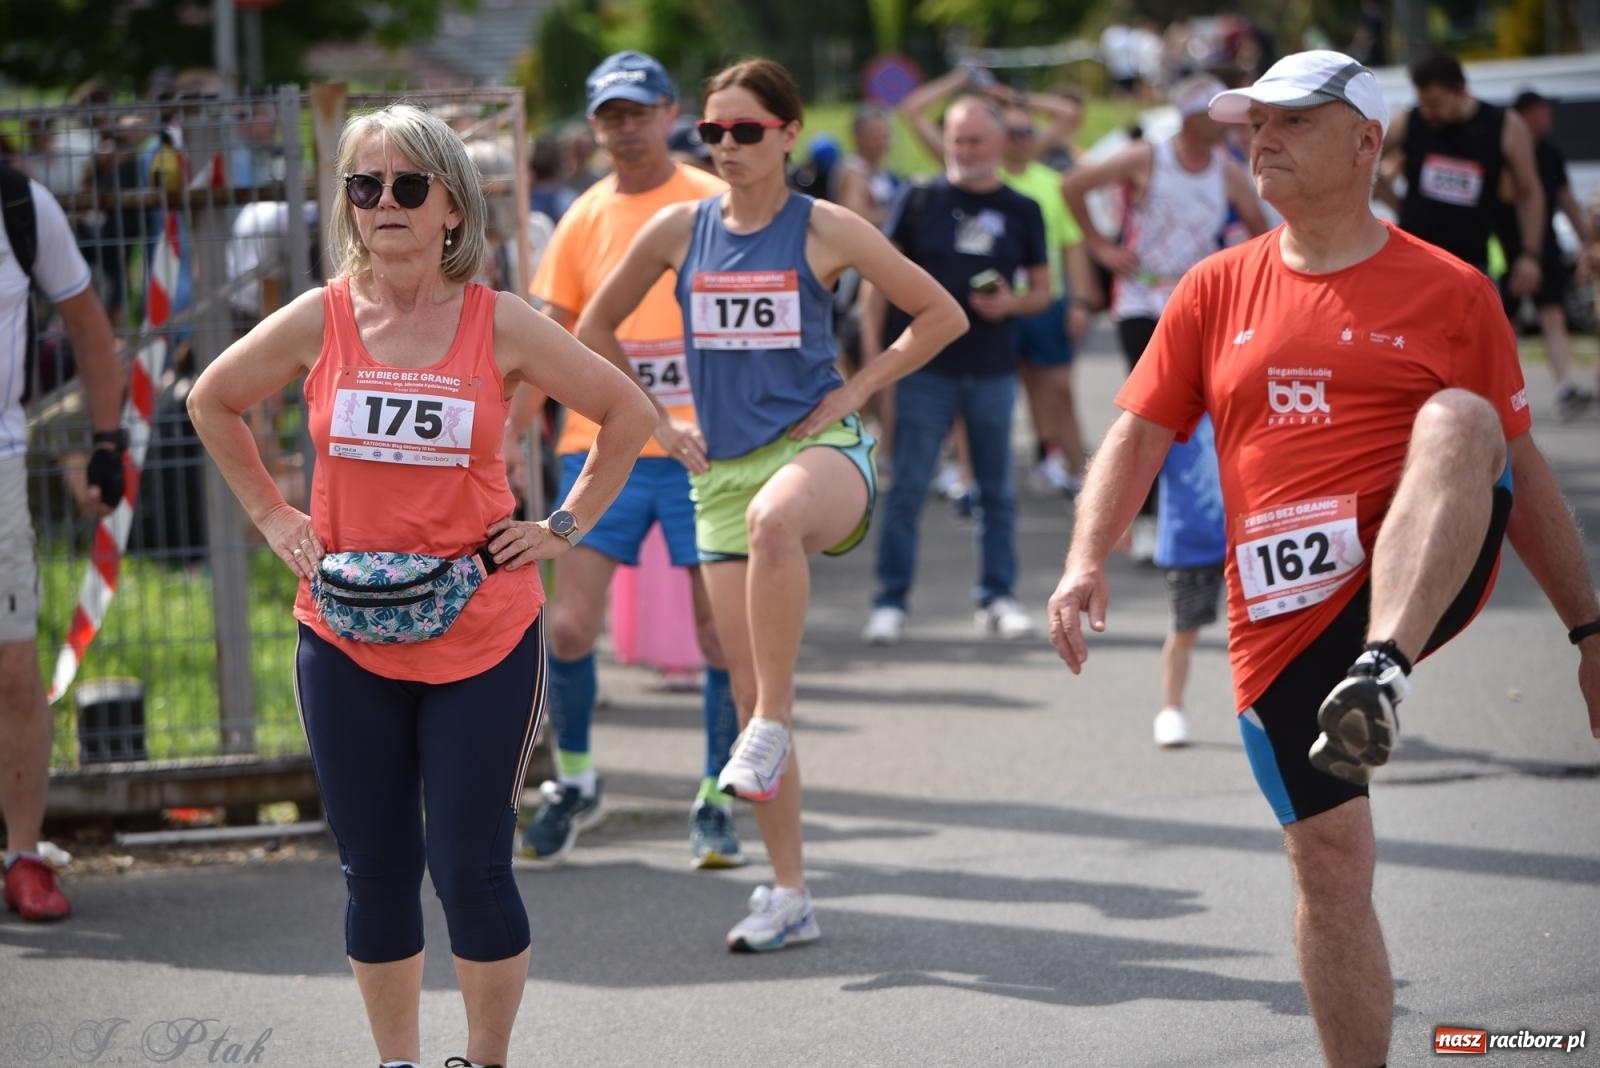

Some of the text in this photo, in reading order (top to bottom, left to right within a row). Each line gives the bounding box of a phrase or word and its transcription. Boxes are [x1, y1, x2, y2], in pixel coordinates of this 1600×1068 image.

[715, 297, 775, 328] 176
[357, 370, 461, 387] XVI BIEG BEZ GRANIC
[1268, 380, 1331, 414] bbl
[365, 395, 443, 440] 175
[1256, 531, 1337, 586] 162
